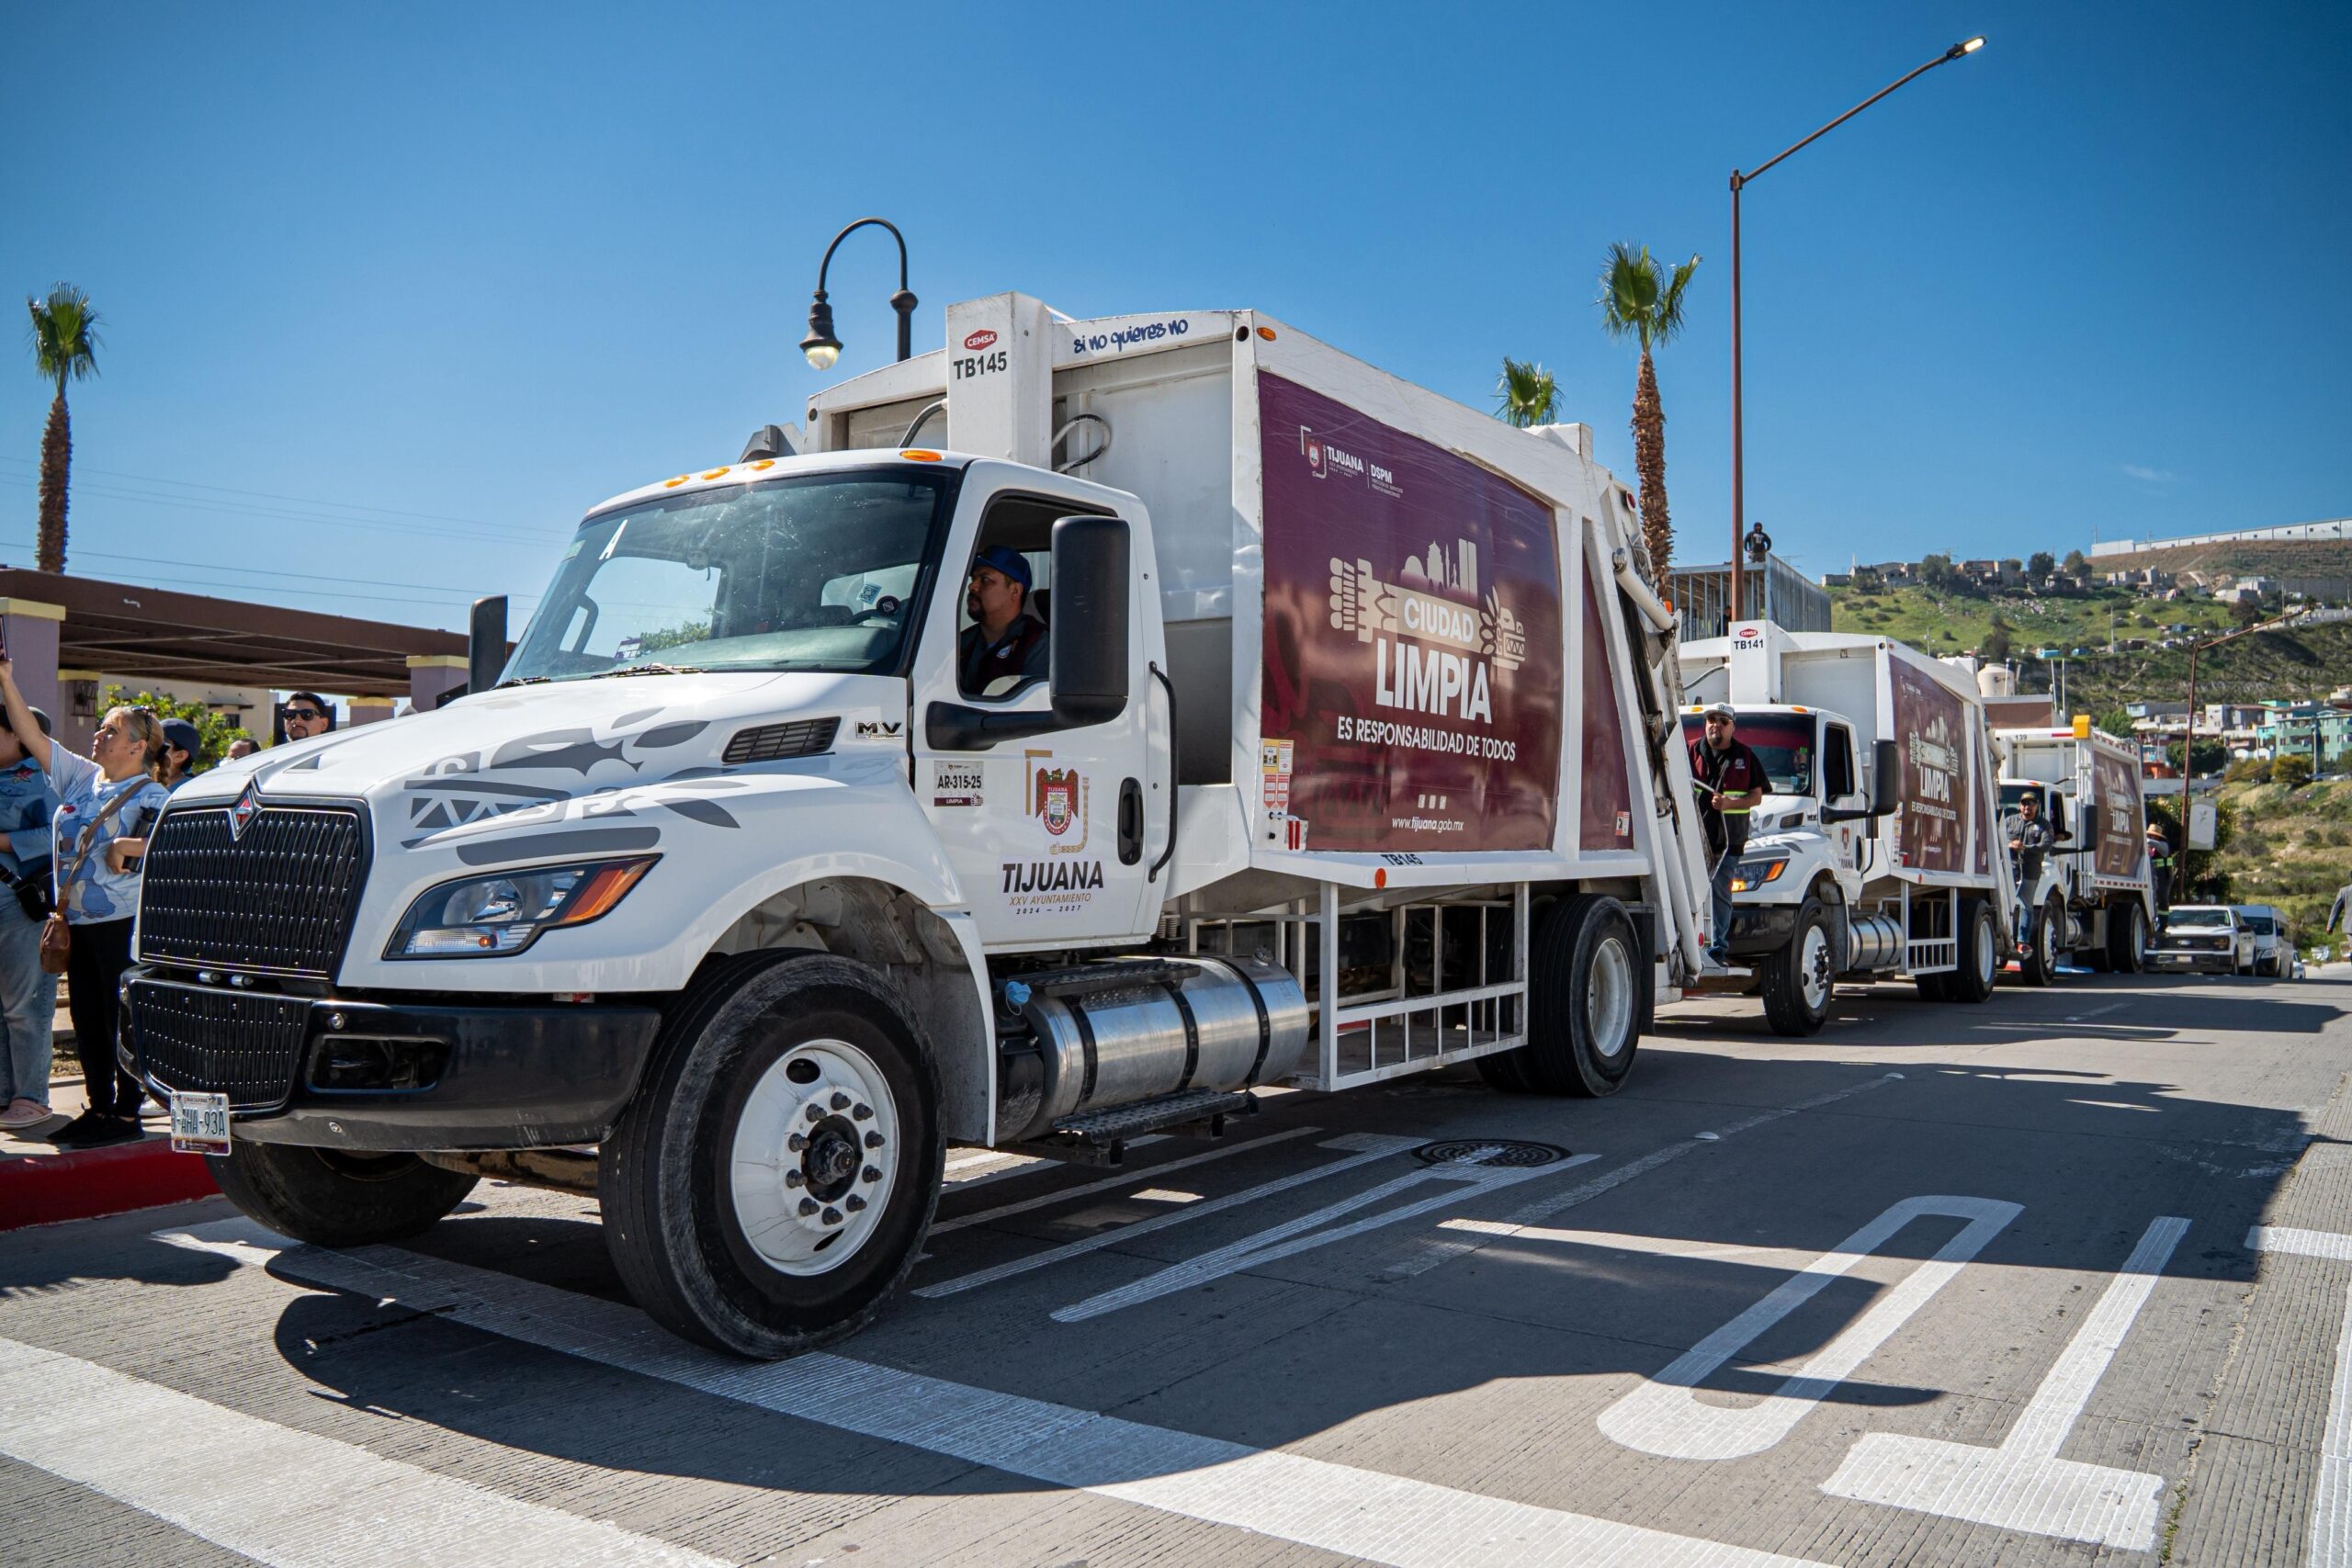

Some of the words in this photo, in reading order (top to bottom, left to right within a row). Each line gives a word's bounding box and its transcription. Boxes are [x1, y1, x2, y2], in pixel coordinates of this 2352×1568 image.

[967, 333, 995, 347] CEMSA
[1073, 335, 1086, 354] si
[1089, 334, 1108, 351] no
[1110, 322, 1167, 353] quieres
[1168, 319, 1189, 336] no
[953, 351, 1007, 380] TB145
[1327, 446, 1364, 473] TIJUANA
[1370, 463, 1393, 484] DSPM
[1403, 596, 1475, 643] CIUDAD
[1734, 639, 1763, 649] TB141
[1375, 637, 1493, 725] LIMPIA
[856, 721, 902, 736] MV
[1337, 716, 1353, 740] ES
[1356, 718, 1464, 754] RESPONSABILIDAD
[1465, 735, 1479, 757] DE
[1481, 738, 1516, 762] TODOS
[937, 774, 982, 789] AR-315-25
[1920, 766, 1950, 804] LIMPIA
[1391, 816, 1464, 833] www.tijuana.gob.mx
[1381, 853, 1424, 866] TB145
[1002, 861, 1104, 894] TIJUANA
[1009, 896, 1029, 907] XXV
[1030, 893, 1092, 906] AYUNTAMIENTO
[1015, 907, 1040, 915] 2024
[1058, 904, 1081, 912] 2027
